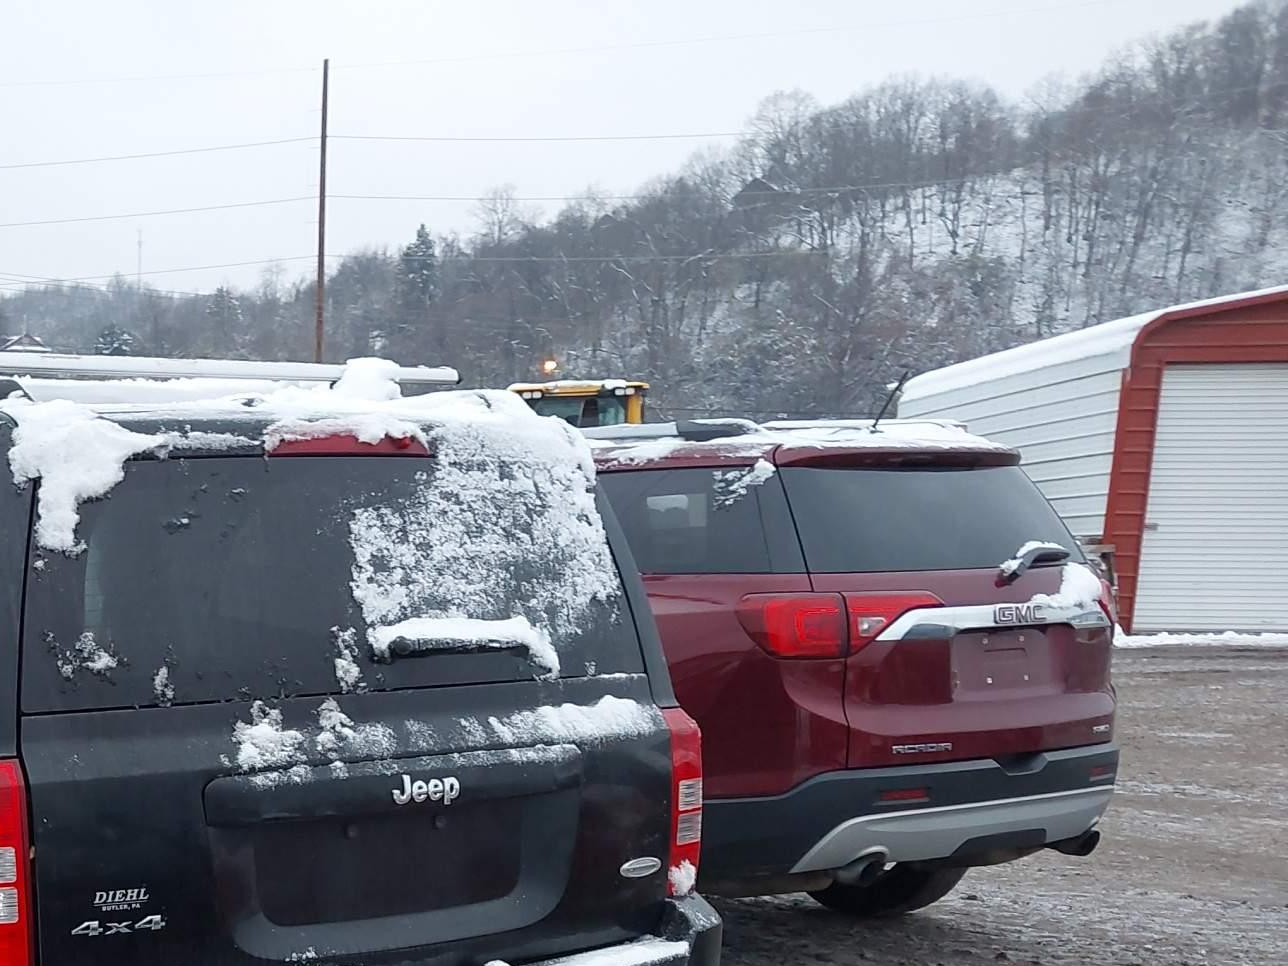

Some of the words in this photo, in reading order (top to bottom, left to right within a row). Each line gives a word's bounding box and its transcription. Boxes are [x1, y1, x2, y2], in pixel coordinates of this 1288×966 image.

[993, 605, 1047, 625] GMC
[392, 774, 460, 805] Jeep
[93, 888, 150, 904] DIEHL
